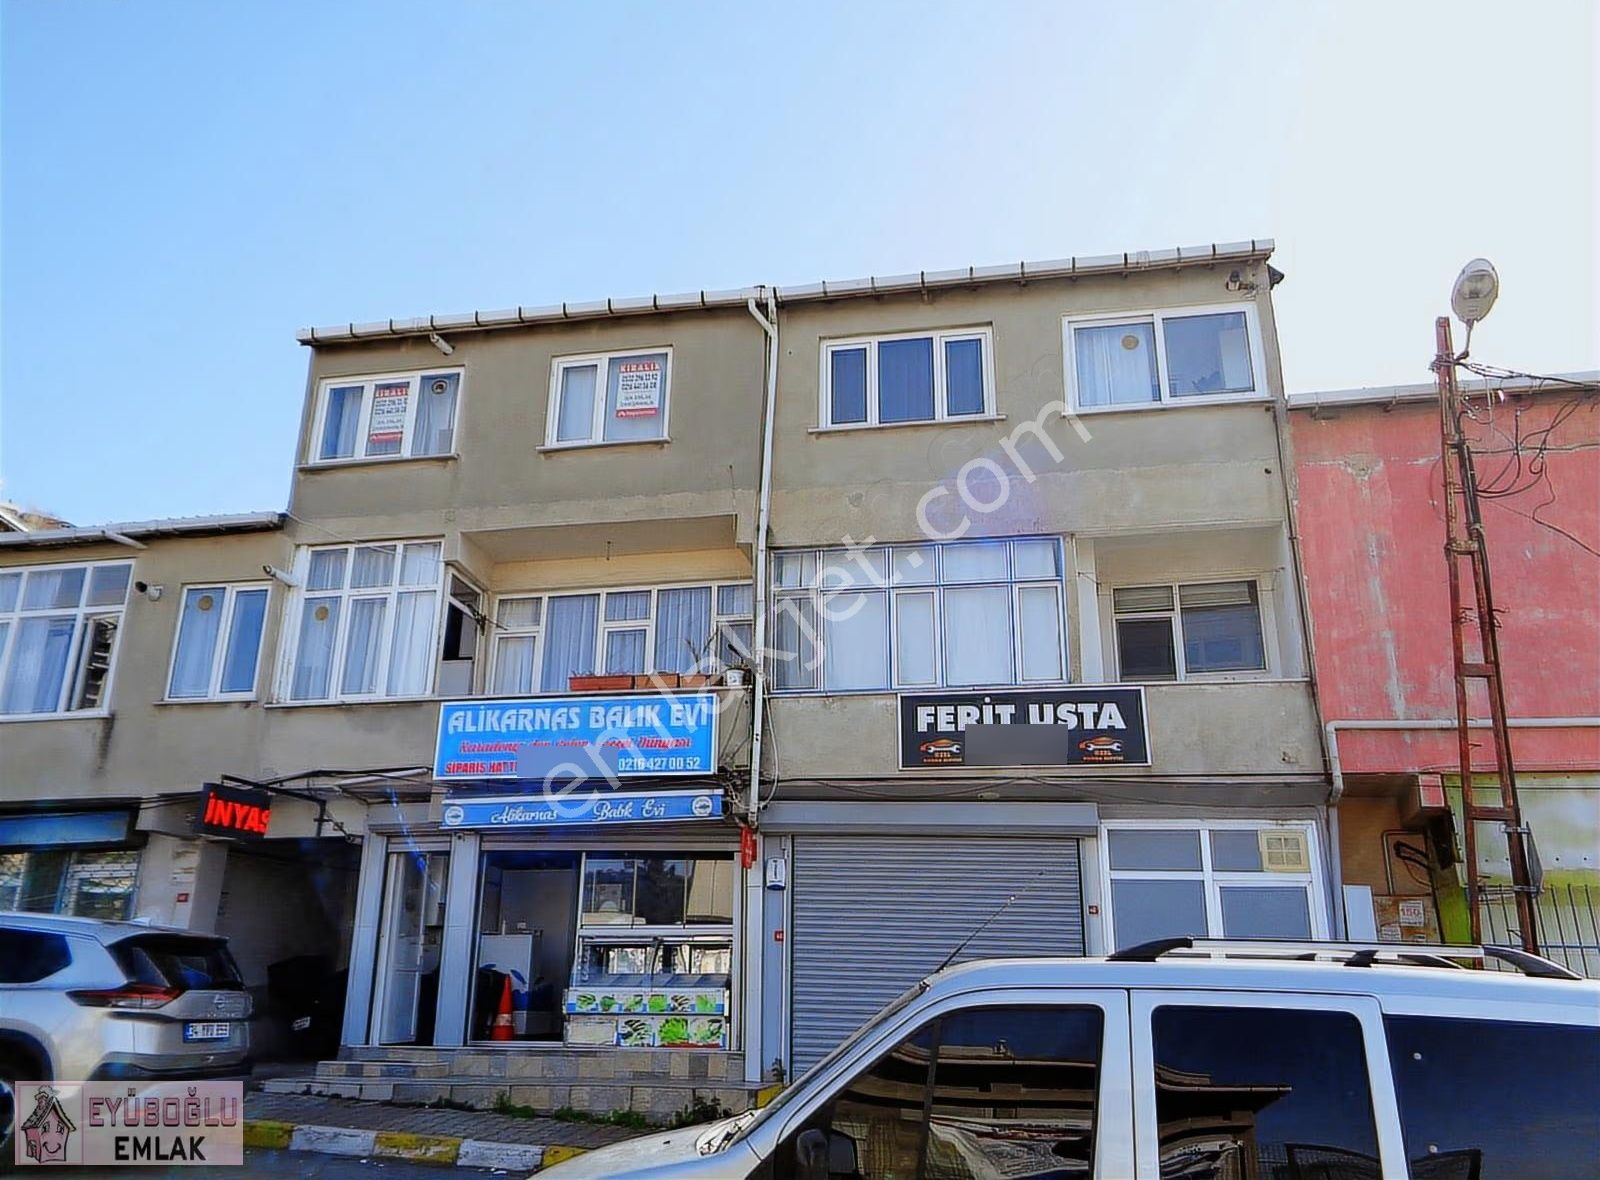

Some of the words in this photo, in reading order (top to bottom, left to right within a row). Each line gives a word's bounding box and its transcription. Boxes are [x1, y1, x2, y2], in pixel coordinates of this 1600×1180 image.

[448, 705, 580, 734] ALİKARNAS
[589, 704, 661, 730] BALIK
[916, 696, 1016, 732] FERİT
[1028, 702, 1127, 730] USTA
[645, 757, 665, 771] 427
[686, 756, 700, 770] 52
[643, 799, 665, 817] Evi
